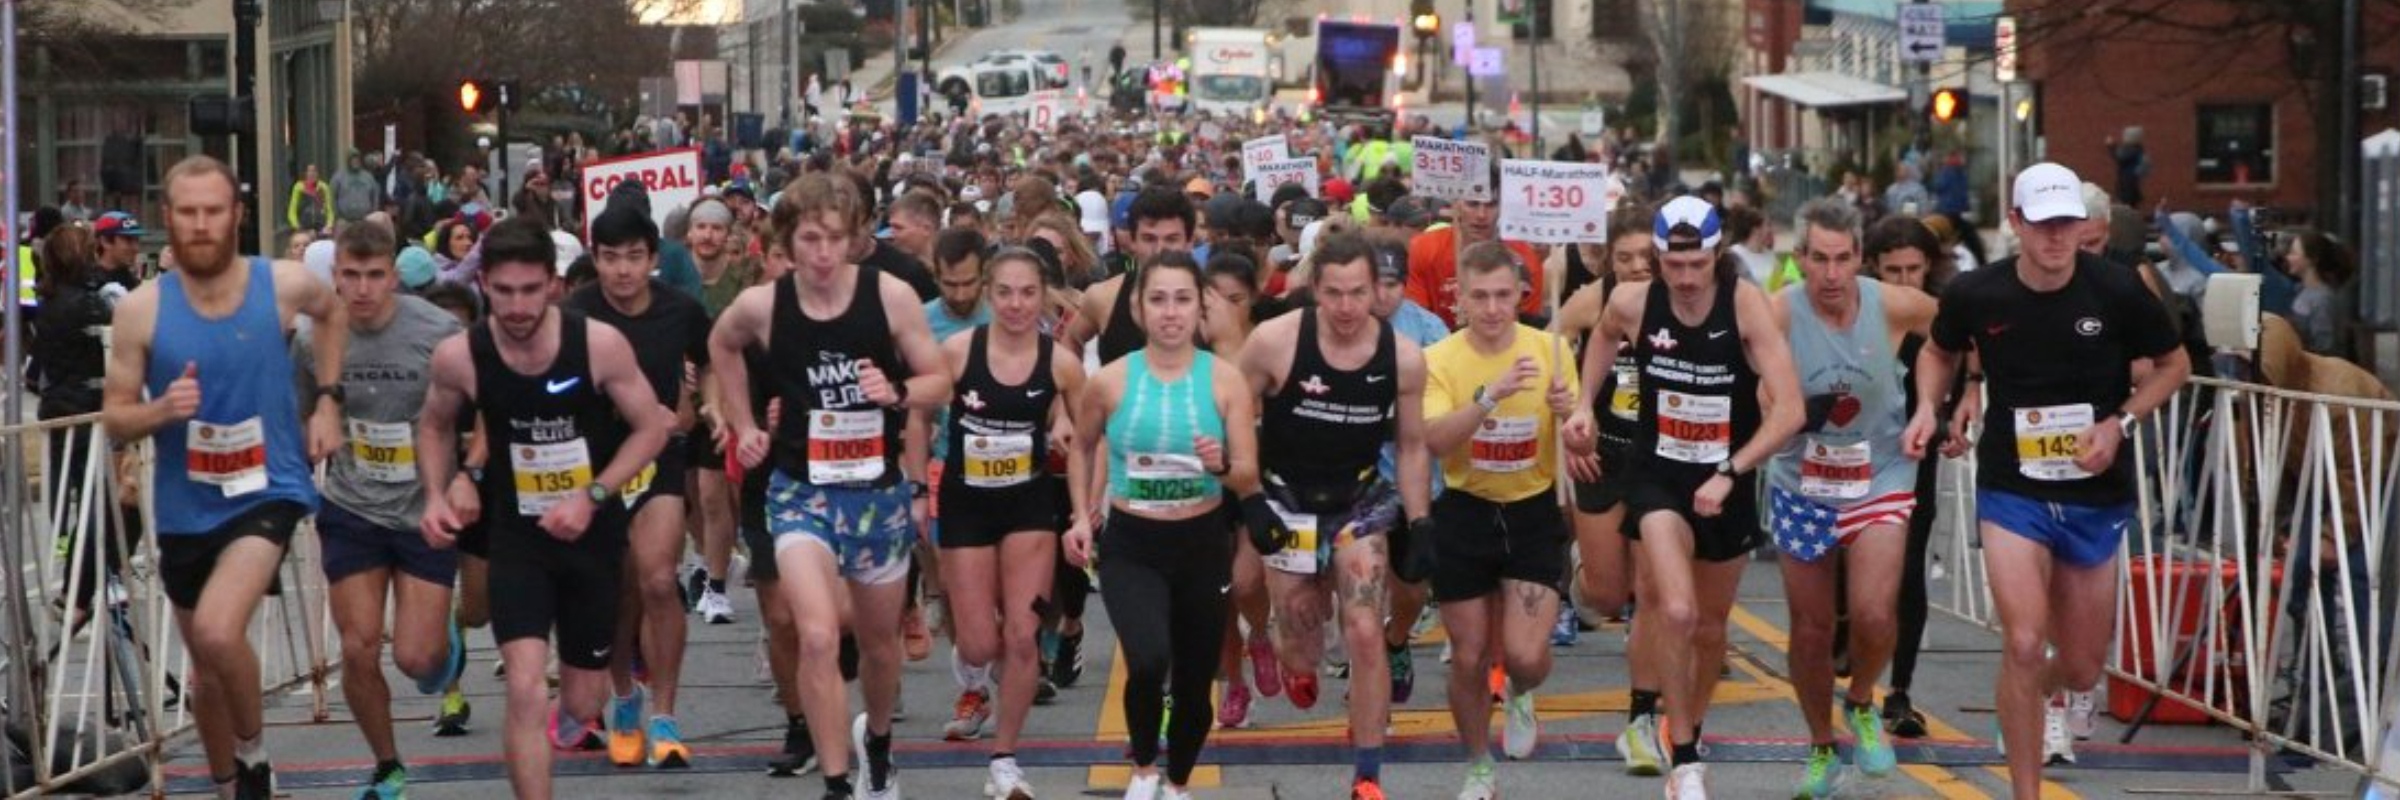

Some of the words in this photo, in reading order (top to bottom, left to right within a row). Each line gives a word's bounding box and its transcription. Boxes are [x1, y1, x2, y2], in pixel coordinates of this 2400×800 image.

[1415, 140, 1486, 156] MARATHON
[1258, 160, 1313, 173] MARATHON
[1417, 152, 1464, 174] 3:15
[1504, 165, 1603, 181] HALF-Marathon
[1522, 185, 1584, 209] 1:30
[531, 427, 575, 442] ELITE
[1667, 417, 1719, 442] 1023
[363, 444, 397, 464] 307
[824, 438, 875, 460] 1006
[1483, 440, 1534, 462] 1032
[2037, 433, 2076, 457] 143
[200, 447, 257, 475] 1024
[981, 457, 1017, 477] 109
[533, 471, 576, 493] 135
[1138, 478, 1194, 500] 5029
